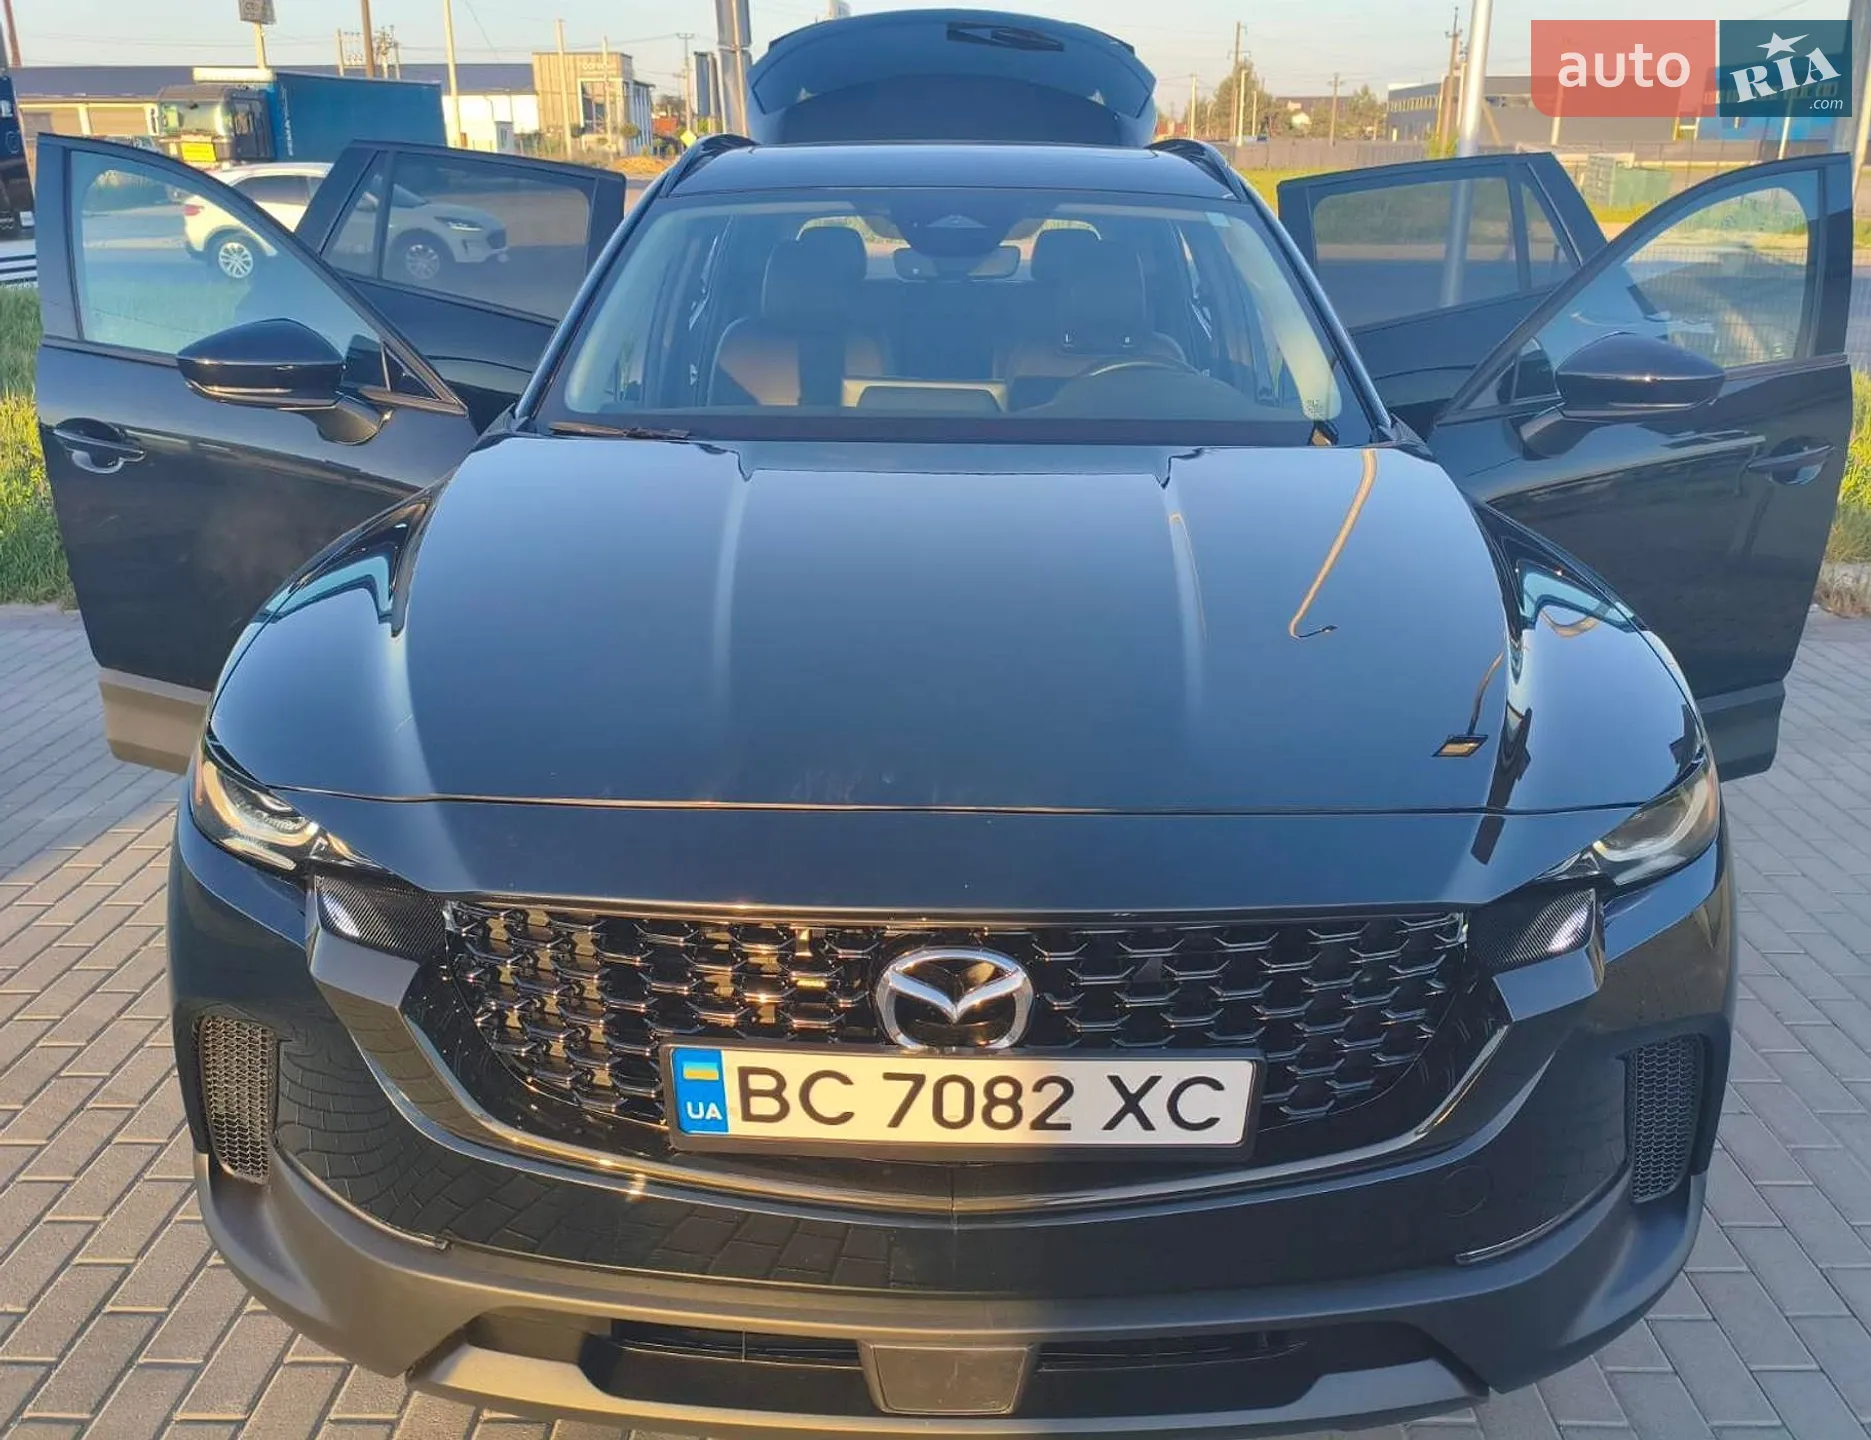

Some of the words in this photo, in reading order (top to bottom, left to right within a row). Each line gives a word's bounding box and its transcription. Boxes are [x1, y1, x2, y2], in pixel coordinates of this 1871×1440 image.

[686, 1101, 722, 1121] UA
[737, 1066, 855, 1126] BC
[882, 1072, 1074, 1131] 7082
[1102, 1075, 1226, 1132] XC
